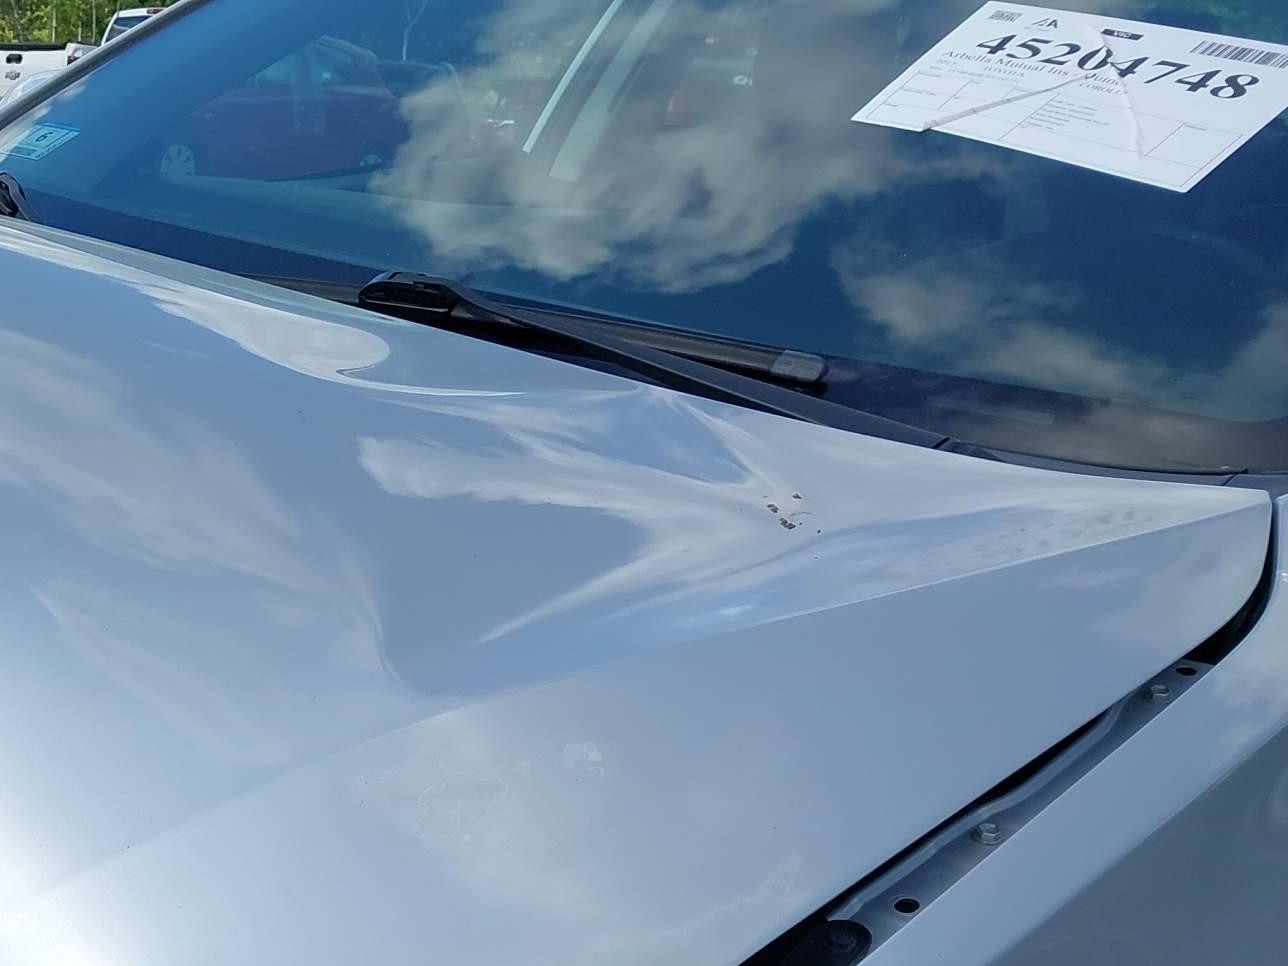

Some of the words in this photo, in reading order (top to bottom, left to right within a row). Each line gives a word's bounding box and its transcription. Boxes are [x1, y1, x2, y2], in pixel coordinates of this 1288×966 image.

[943, 49, 992, 64] Arbella
[997, 57, 1045, 72] Mutual
[1047, 66, 1070, 77] Ins
[976, 34, 1260, 98] 45204748
